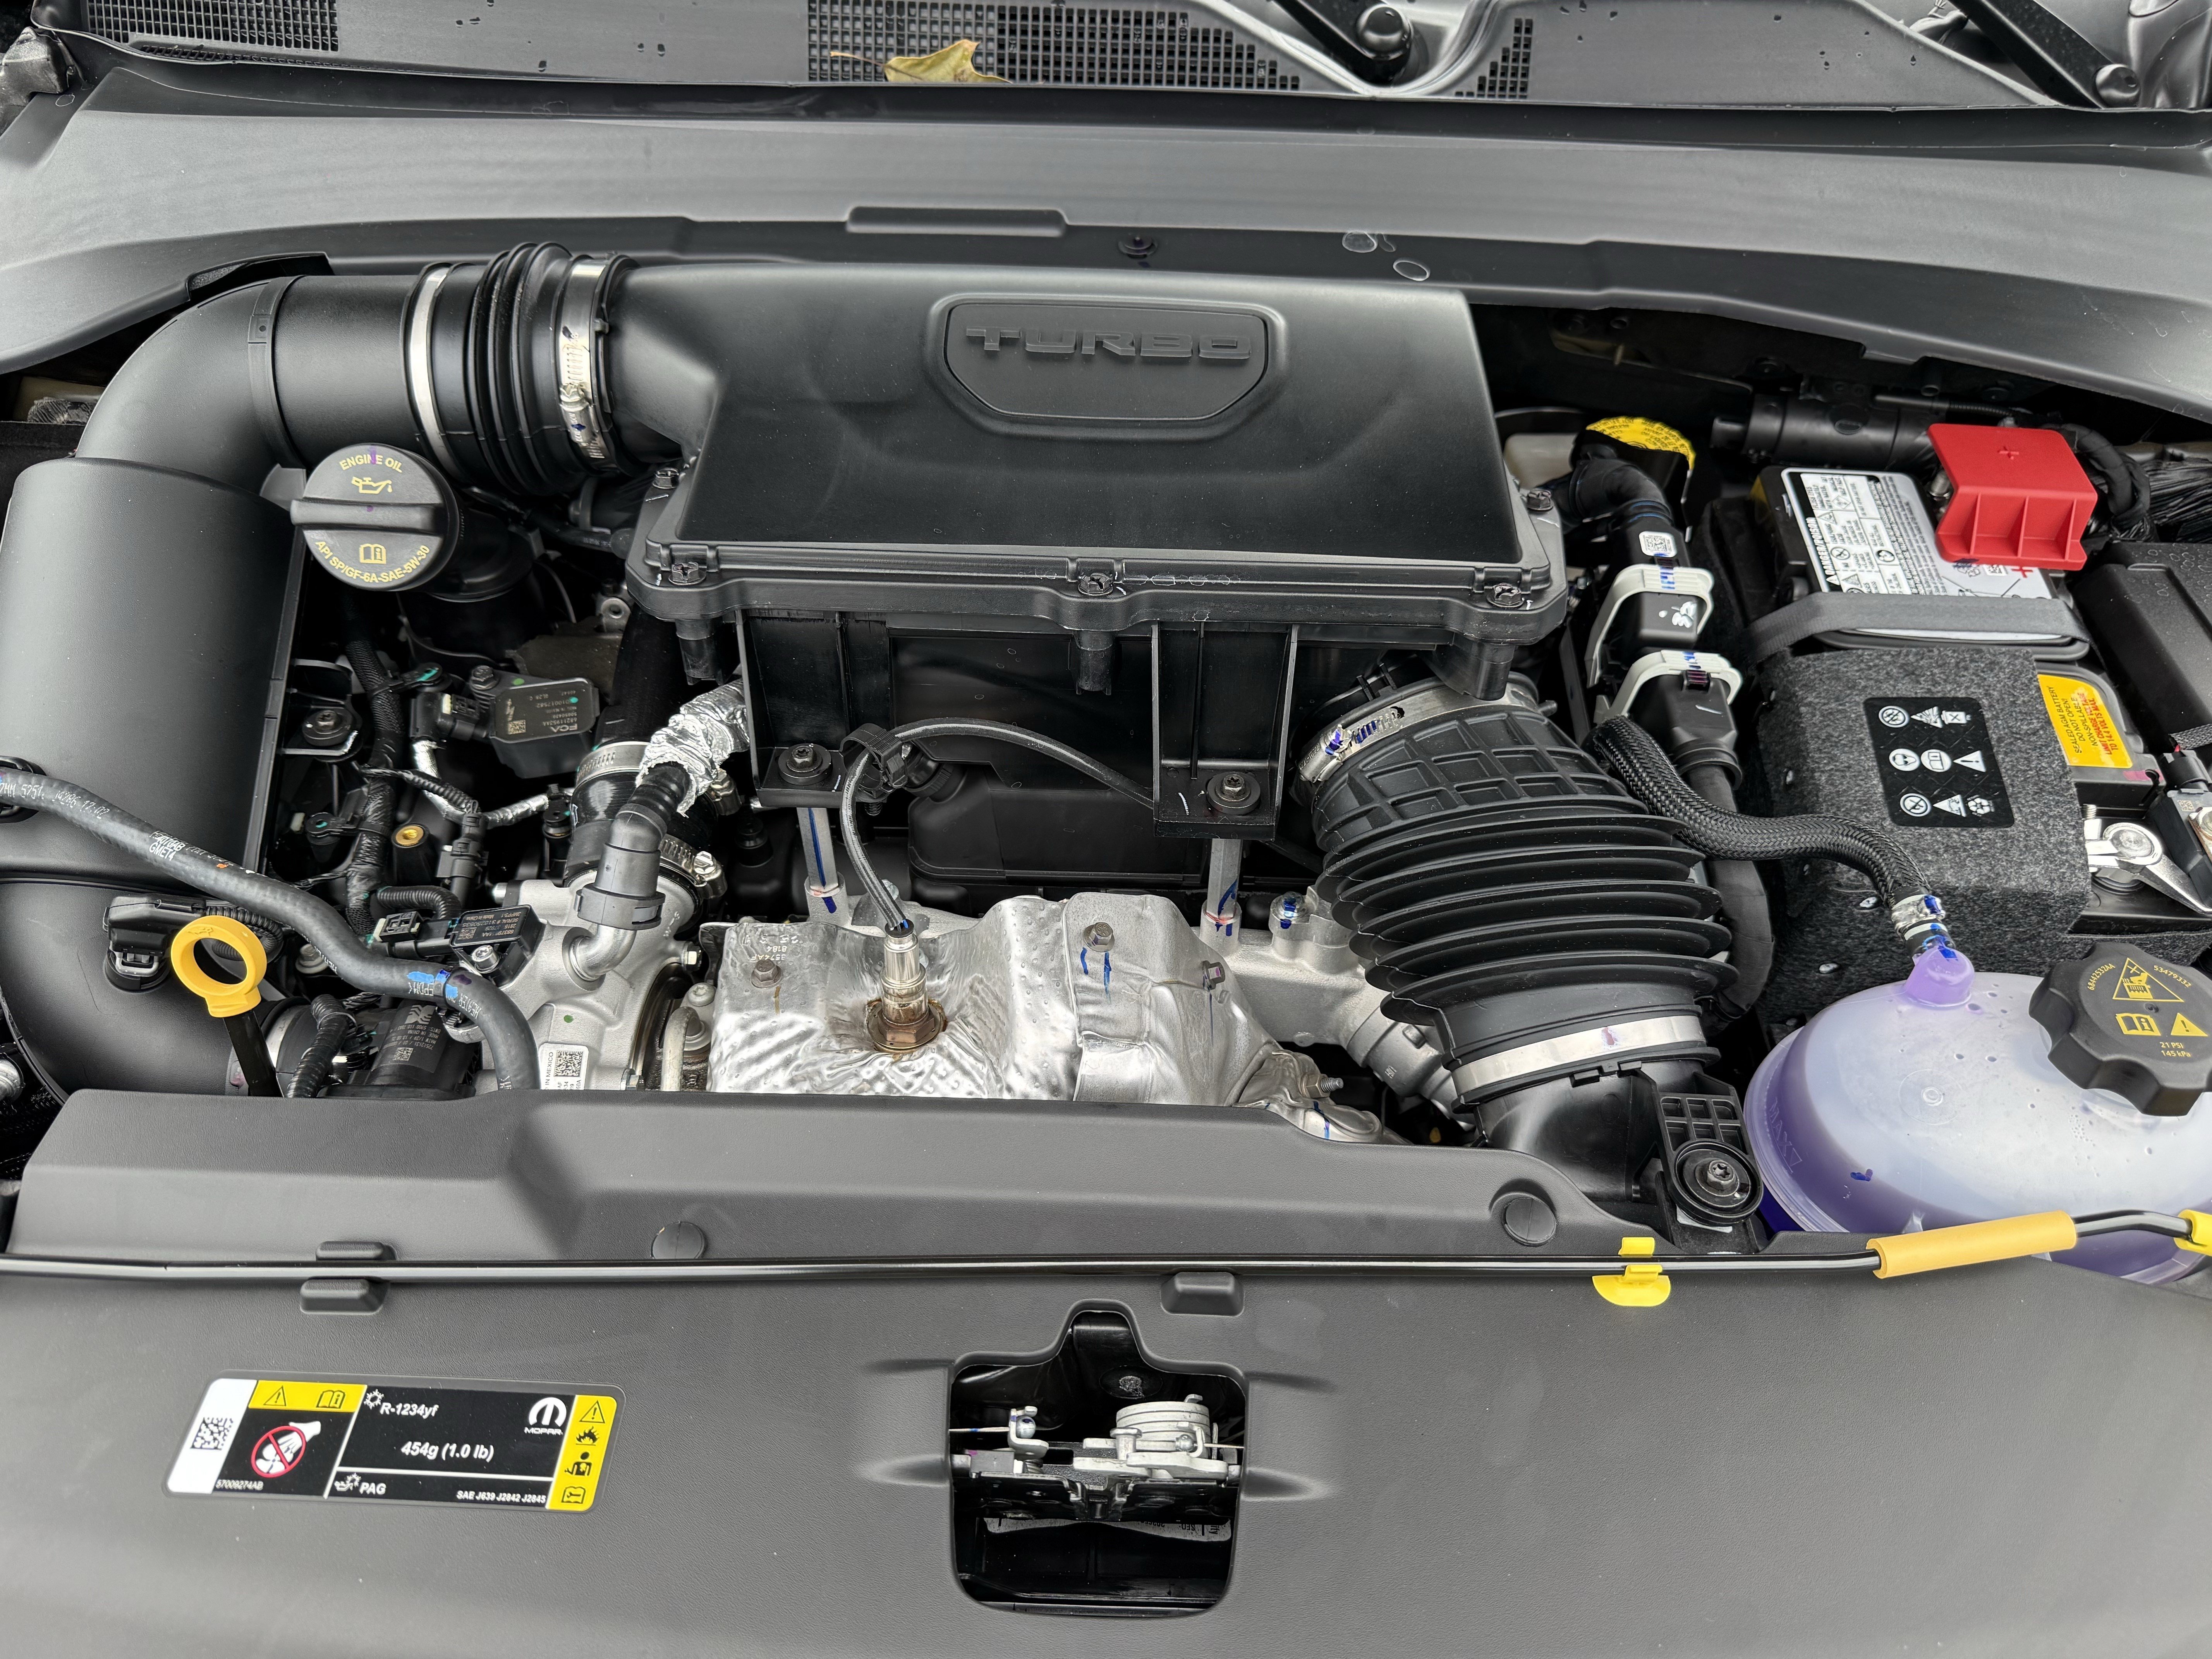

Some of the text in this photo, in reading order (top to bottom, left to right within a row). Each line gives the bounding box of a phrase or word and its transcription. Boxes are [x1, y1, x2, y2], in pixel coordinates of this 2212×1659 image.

[966, 326, 1251, 359] TURBO
[339, 454, 403, 473] ENGINE OIL
[315, 541, 333, 559] API
[1806, 517, 1836, 575] DANGER/POISON
[551, 723, 578, 733] FCA
[2046, 685, 2082, 753] SEALED AGM BATTERY
[2060, 697, 2086, 741] DO NOT OPEN!
[2070, 697, 2099, 746] NON-SPILLABLE
[2088, 716, 2105, 738] CHARGE
[2094, 712, 2109, 730] VOLTS
[2098, 739, 2112, 755] LIMIT
[149, 842, 176, 861] GMET4
[2087, 963, 2116, 990] 68442532AA
[2153, 965, 2192, 988] 53479332
[459, 993, 481, 1019] HEATER
[380, 1402, 439, 1419] R-1234yf
[524, 1426, 564, 1436] MOPAR
[400, 1443, 494, 1463] 454g (1.0 lb)
[359, 1482, 386, 1496] PAG
[456, 1490, 546, 1504] SAE J639 J2842 J2845
